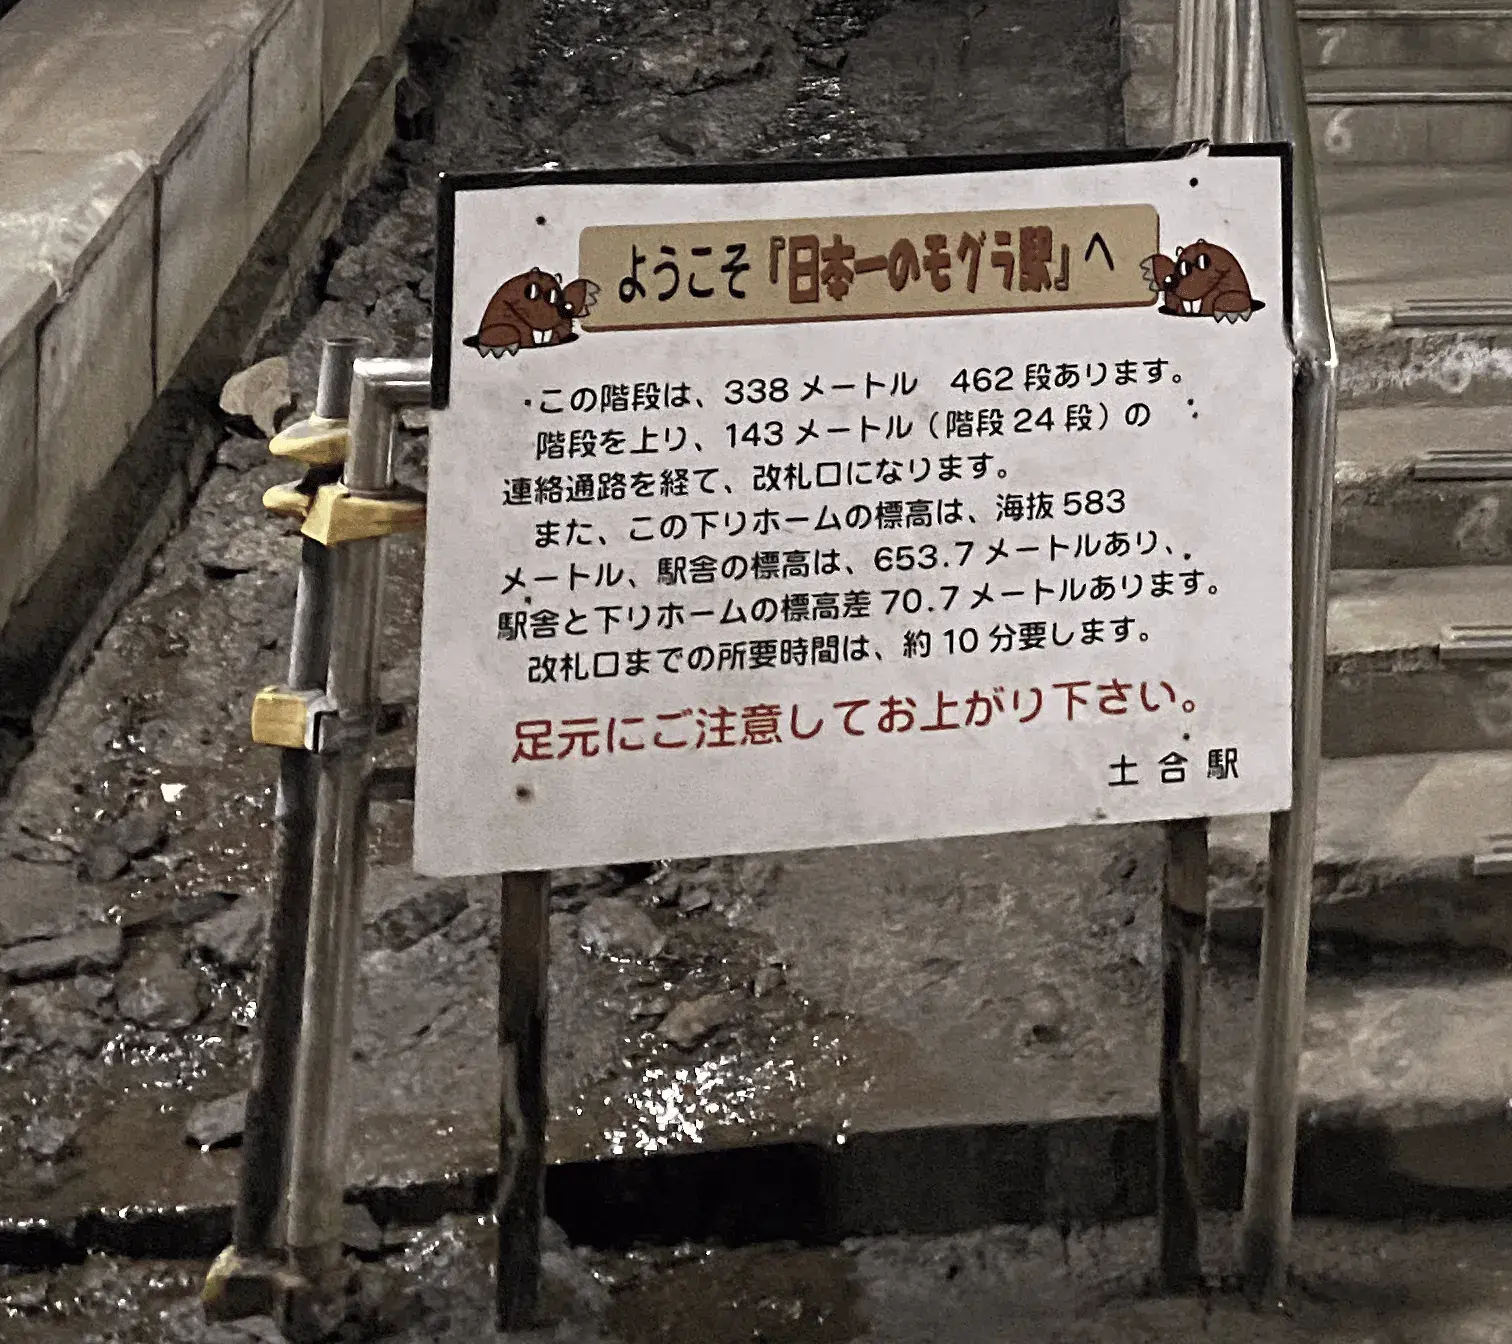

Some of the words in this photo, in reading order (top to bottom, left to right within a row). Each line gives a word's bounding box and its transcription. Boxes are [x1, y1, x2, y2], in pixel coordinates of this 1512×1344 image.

[1317, 27, 1347, 64] 7
[1324, 108, 1354, 154] 6
[511, 677, 1196, 764] 足元にご注意してお上がり下さい。
[1107, 747, 1240, 788] 土合駅
